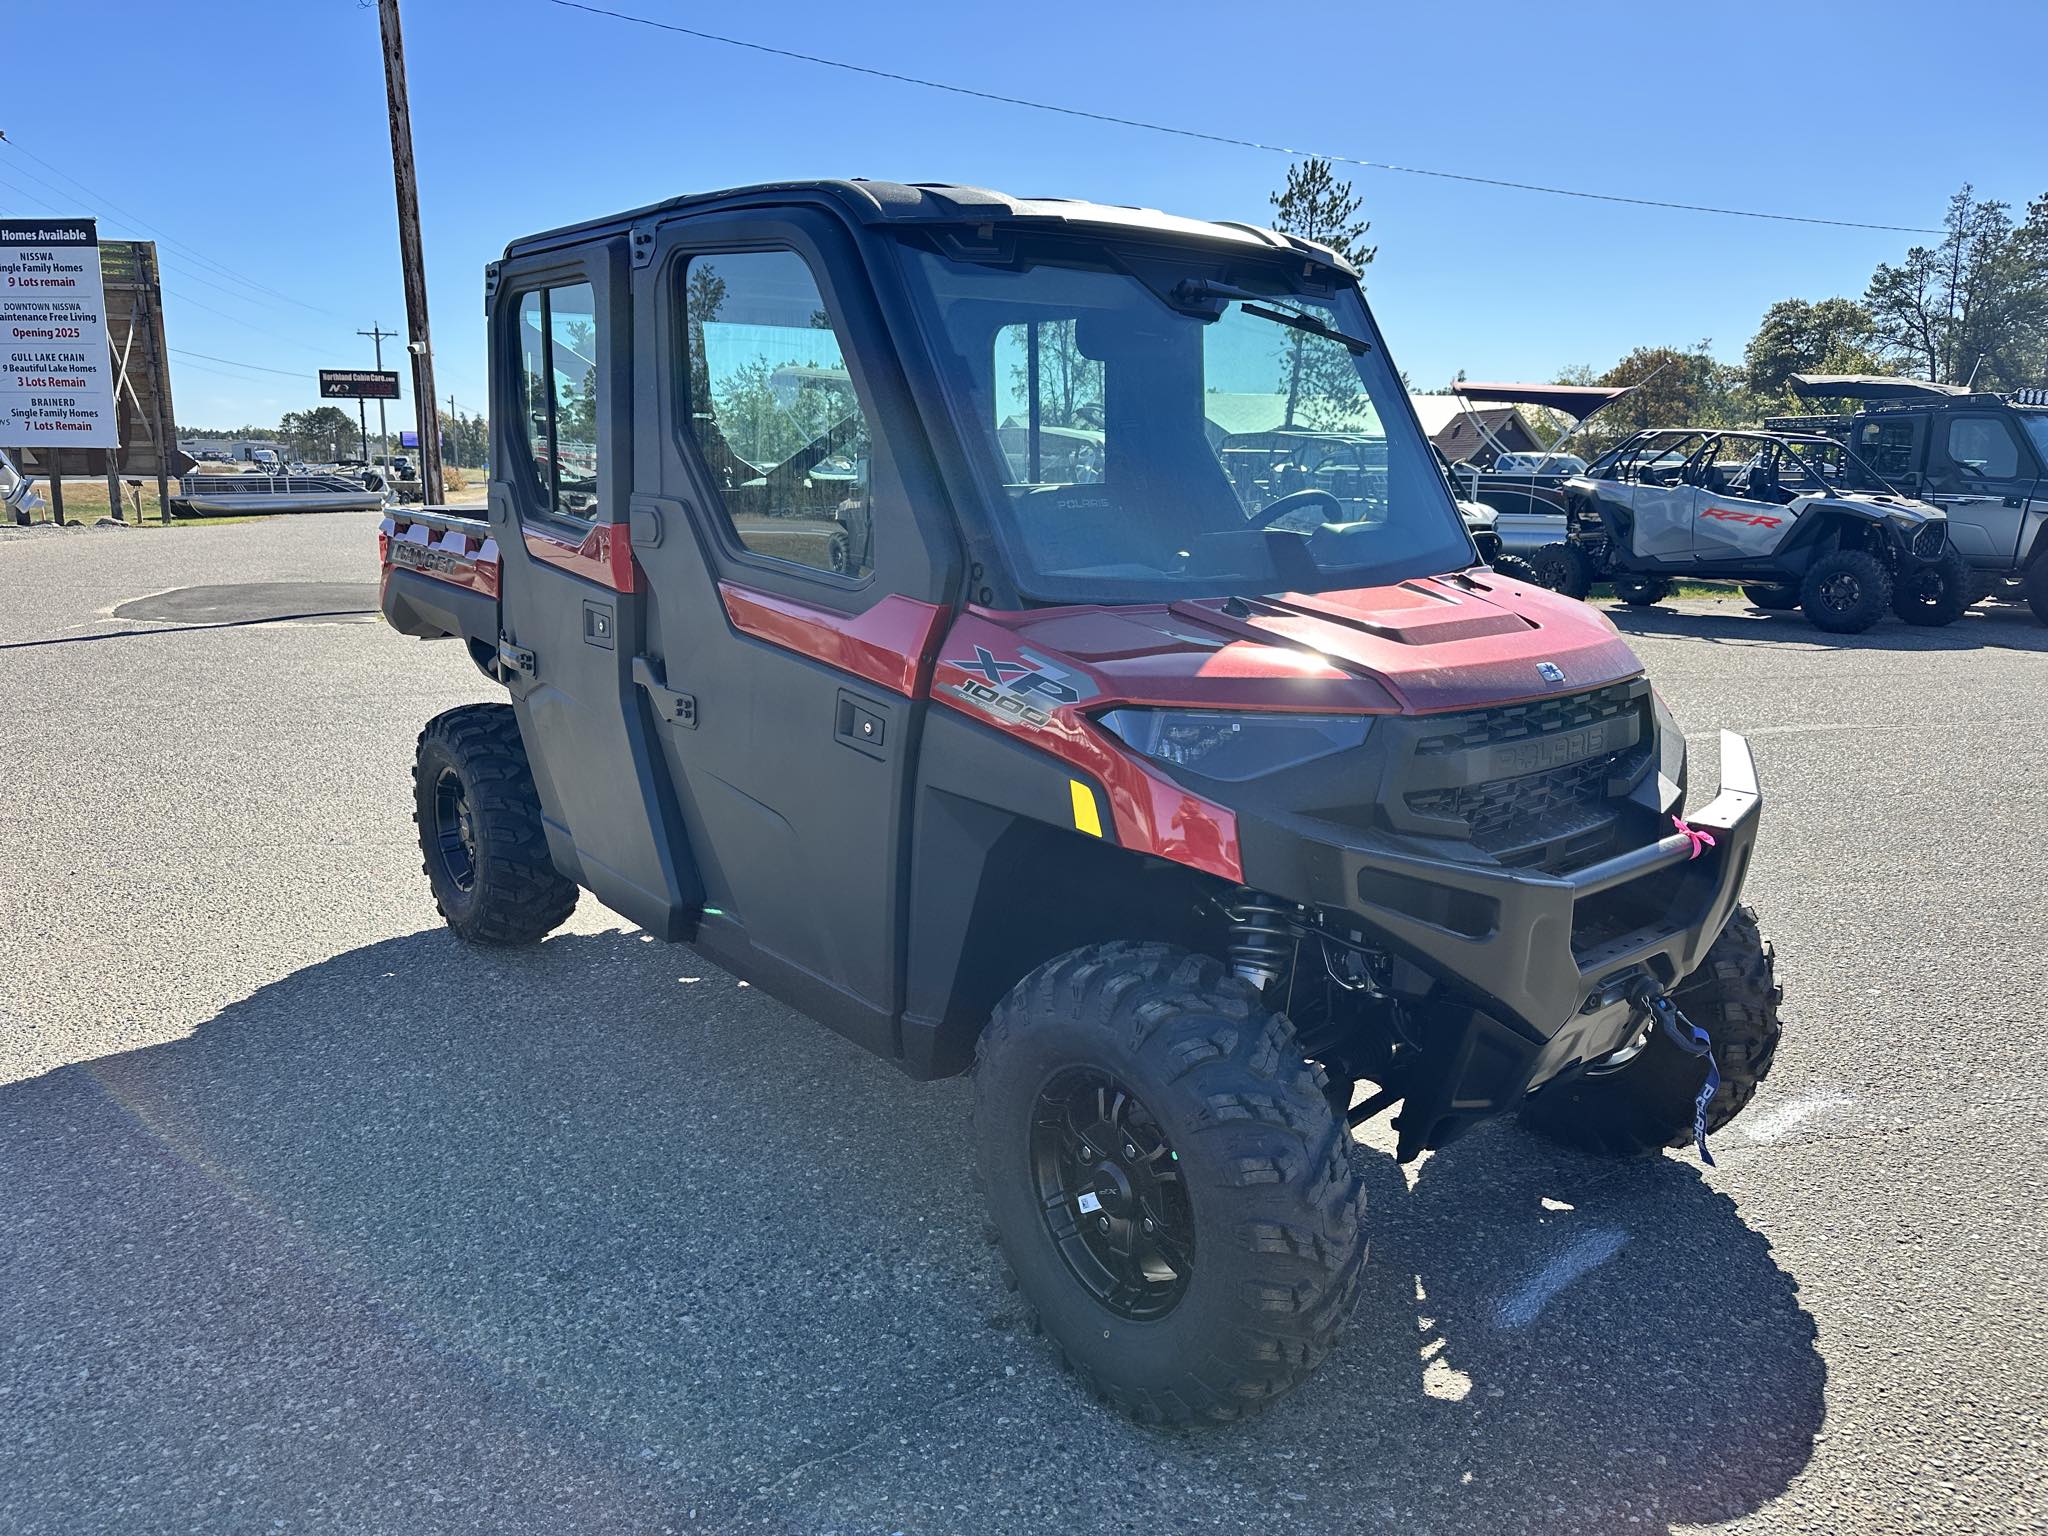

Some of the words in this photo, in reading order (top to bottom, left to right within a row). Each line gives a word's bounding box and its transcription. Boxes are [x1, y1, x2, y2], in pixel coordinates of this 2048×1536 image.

[1, 229, 36, 241] Homes
[38, 229, 87, 241] Available
[20, 252, 54, 261] NISSWA
[22, 263, 51, 274] Family
[53, 263, 83, 272] Homes
[8, 276, 15, 287] 9
[18, 276, 38, 287] Lots
[40, 276, 75, 287] remain
[4, 303, 50, 311] DOWNTOWN
[52, 303, 81, 311] NISSWA
[49, 312, 69, 321] Free
[70, 312, 96, 323] Living
[12, 327, 53, 339] Opening
[54, 327, 80, 338] 2025
[11, 353, 32, 362] GULL
[34, 353, 56, 362] LAKE
[58, 353, 85, 362] CHAIN
[2, 364, 8, 373] 9
[9, 364, 47, 373] Beautiful
[48, 364, 68, 373] Lake
[69, 364, 97, 373] Homes
[17, 376, 24, 387] 3
[25, 376, 46, 387] Lots
[48, 376, 86, 388] Remain
[322, 373, 352, 381] Northland
[31, 398, 76, 407] BRAINERD
[11, 409, 37, 420] Single
[39, 409, 68, 420] Family
[69, 409, 99, 418] Homes
[24, 421, 31, 431] 7
[34, 421, 54, 431] Lots
[56, 421, 92, 431] Remain
[1698, 507, 1783, 529] RZR
[392, 541, 457, 575] RANGER
[944, 644, 1081, 704] XP
[952, 678, 1053, 728] 1000
[1499, 727, 1605, 769] POLARIS
